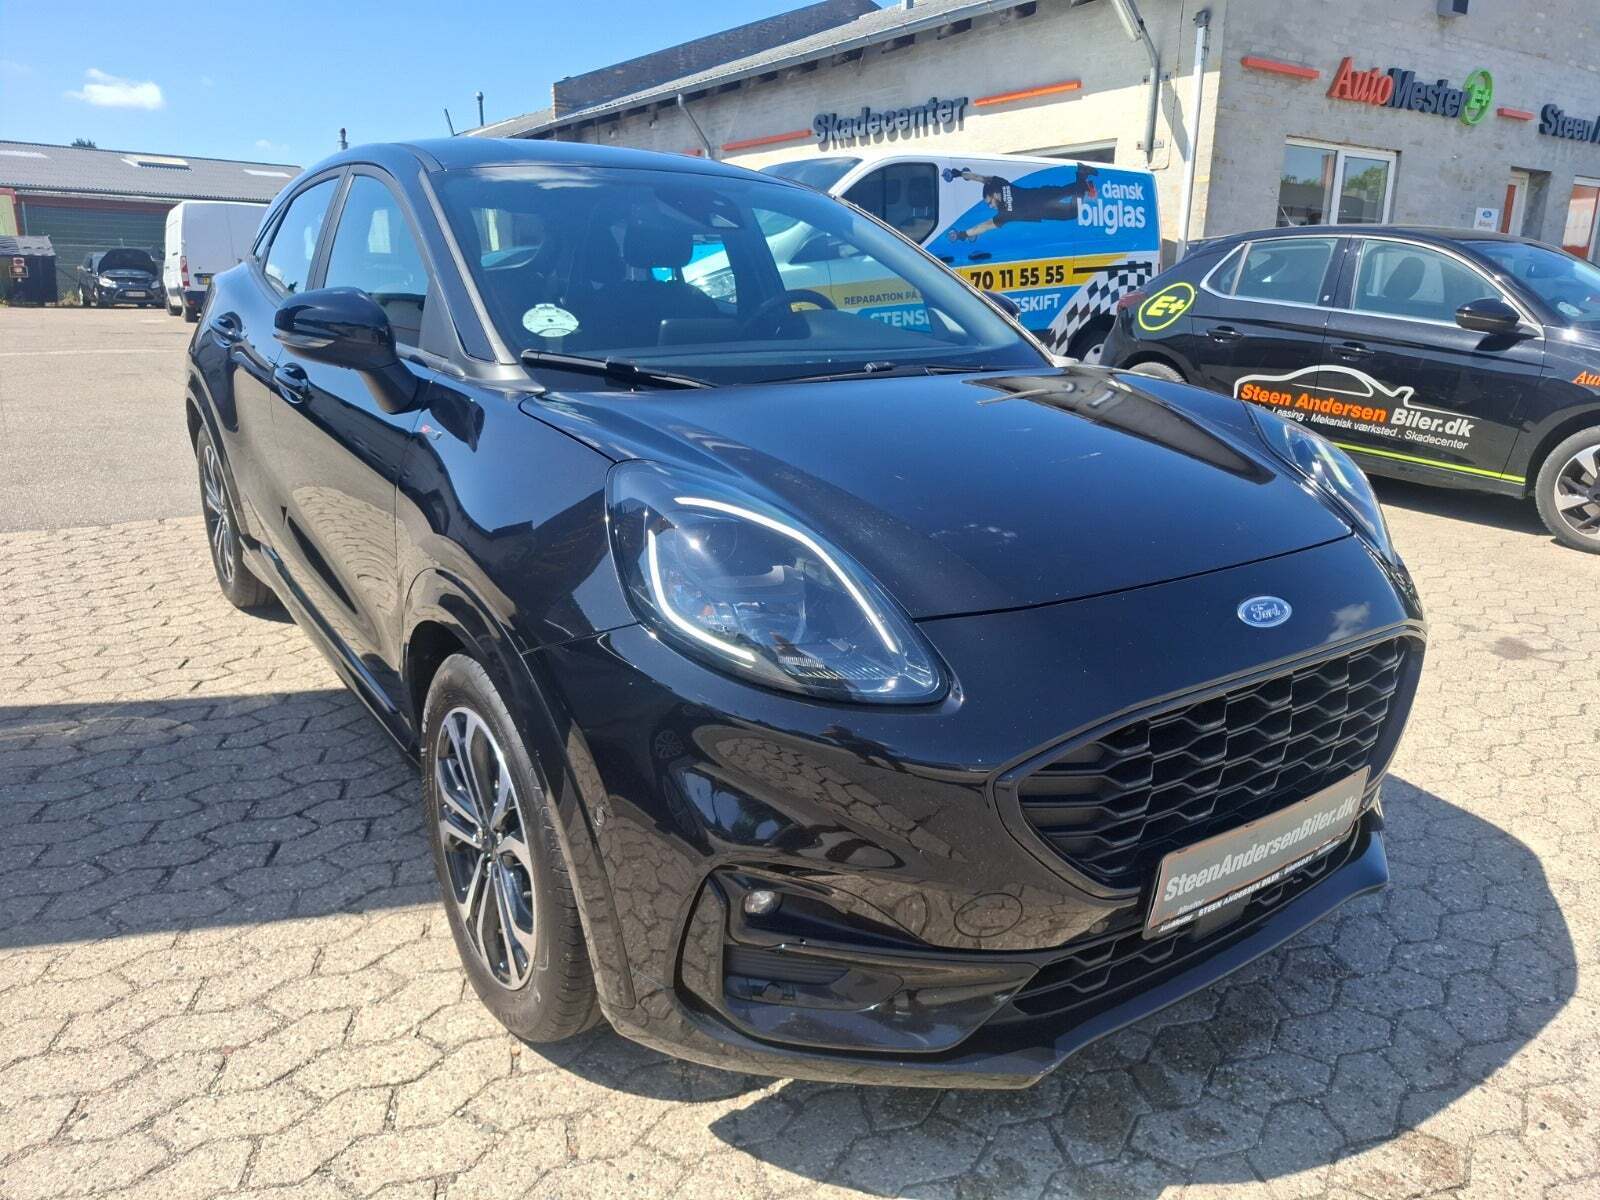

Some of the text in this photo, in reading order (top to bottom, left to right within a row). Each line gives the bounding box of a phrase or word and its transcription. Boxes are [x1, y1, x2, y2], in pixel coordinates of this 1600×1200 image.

[813, 97, 969, 143] Skadecenter
[1102, 180, 1144, 200] dansk
[1077, 197, 1146, 235] bilglas
[970, 265, 1065, 290] 70 11 55 55
[844, 292, 903, 305] REPARATION
[1241, 383, 1475, 437] Steen Andersen Biler.dk
[1311, 413, 1353, 430] Mekanisk
[1404, 430, 1469, 449] Skadecenter
[1250, 602, 1281, 621] Ford
[1164, 796, 1357, 902] SteenAndersenBiler.dk
[1199, 900, 1223, 916] STEEN
